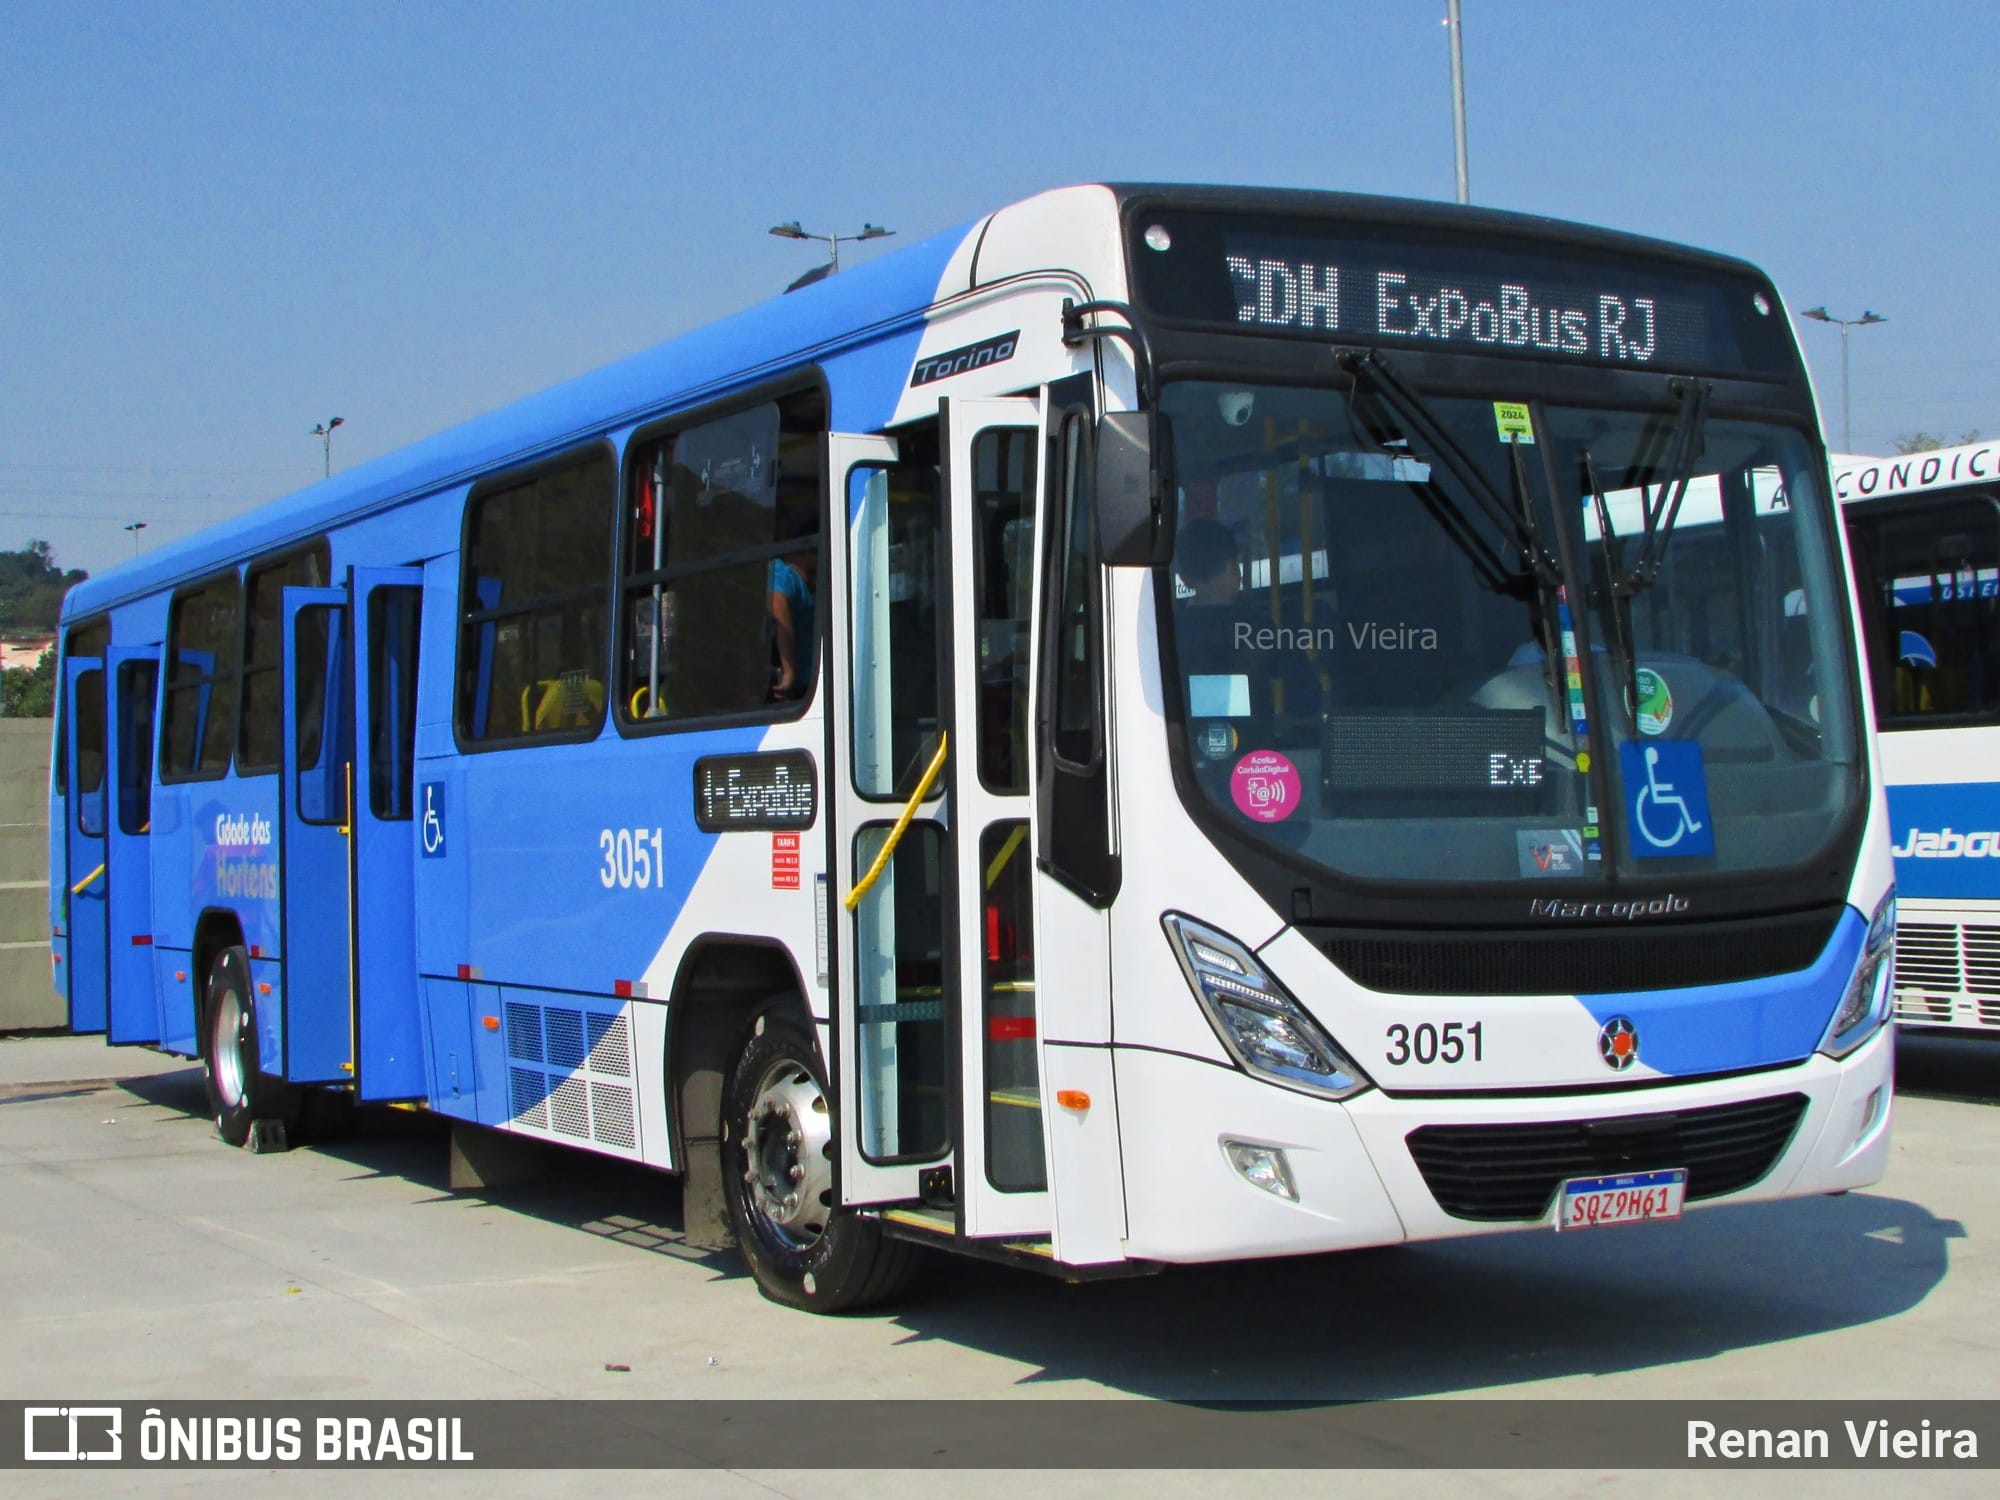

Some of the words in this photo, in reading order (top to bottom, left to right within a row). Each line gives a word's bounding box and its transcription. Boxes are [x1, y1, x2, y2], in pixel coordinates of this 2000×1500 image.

[1599, 294, 1655, 361] RJ
[916, 340, 1014, 382] Torino
[1501, 409, 1525, 420] 2024
[1836, 448, 2000, 498] CONDIC
[216, 812, 250, 846] Cidade
[252, 812, 271, 846] das
[600, 827, 664, 889] 3051
[1529, 893, 1690, 920] Marcopolo
[1385, 1020, 1482, 1066] 3051
[1572, 1186, 1669, 1222] SQZ9H61
